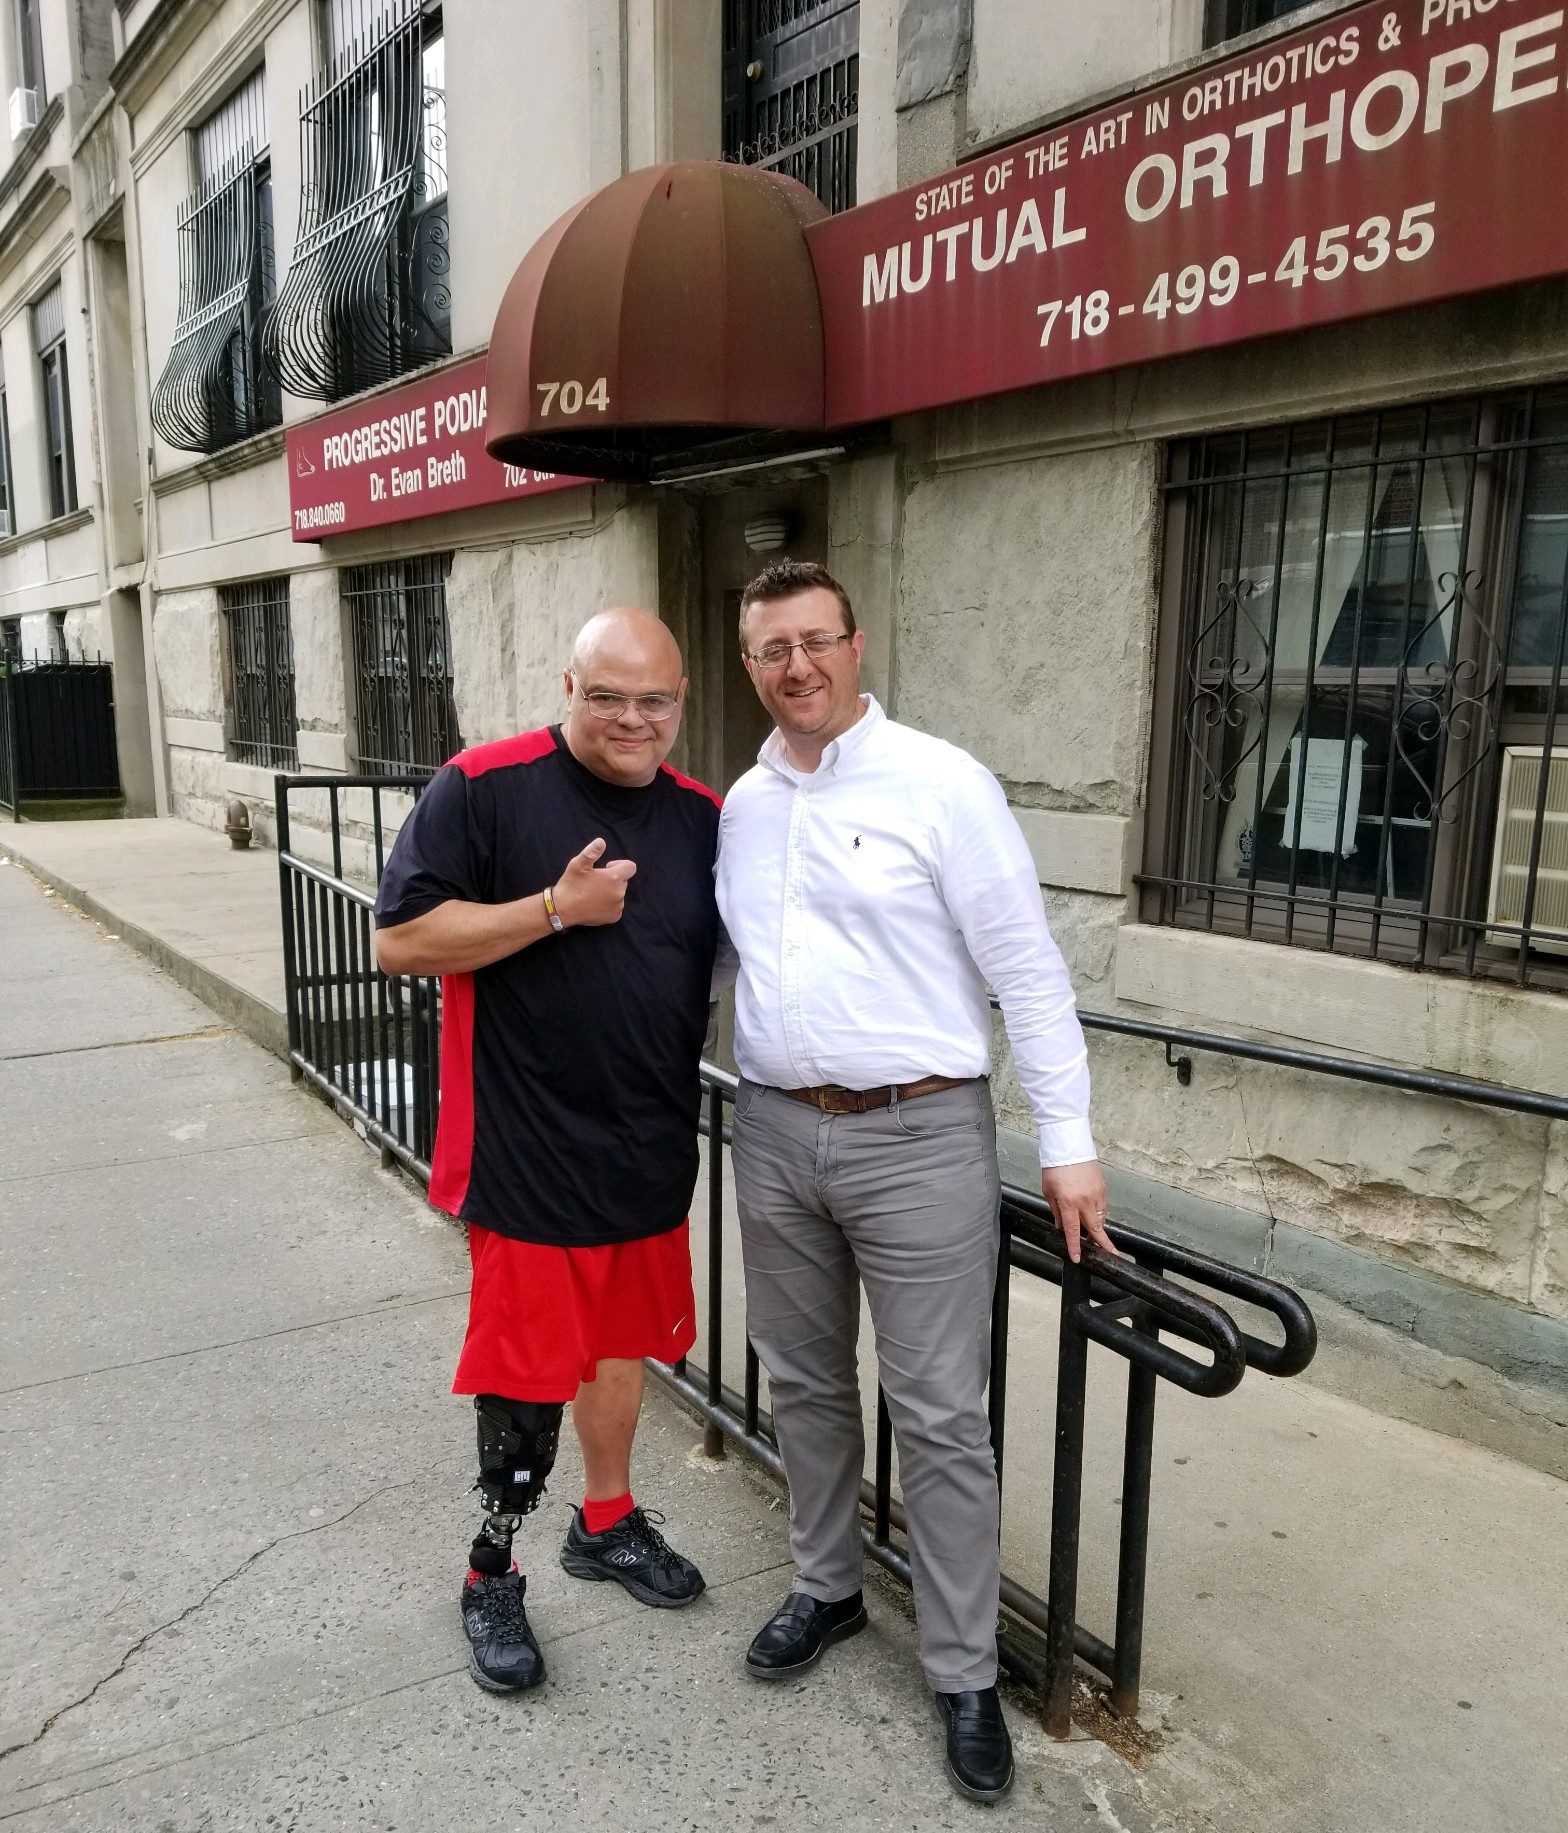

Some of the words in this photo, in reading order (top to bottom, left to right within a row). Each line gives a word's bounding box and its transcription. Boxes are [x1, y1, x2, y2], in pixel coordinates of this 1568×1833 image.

[915, 174, 974, 221] STATE
[984, 158, 1014, 195] OF
[1025, 135, 1068, 179] THE
[1081, 112, 1133, 159] ART
[1145, 97, 1170, 136] IN
[1182, 26, 1360, 121] ORTHOTICS
[1378, 12, 1401, 51] &
[1421, 0, 1518, 36] PR
[863, 187, 1087, 306] MUTUAL
[1124, 10, 1568, 222] ORTHOPE
[537, 377, 610, 416] 704
[323, 407, 427, 471] PROGRESSIVE
[370, 472, 387, 502] Dr.
[391, 466, 423, 498] Evan
[427, 449, 466, 489] Breth
[503, 462, 527, 488] 702
[294, 501, 346, 531] 718.840.0660
